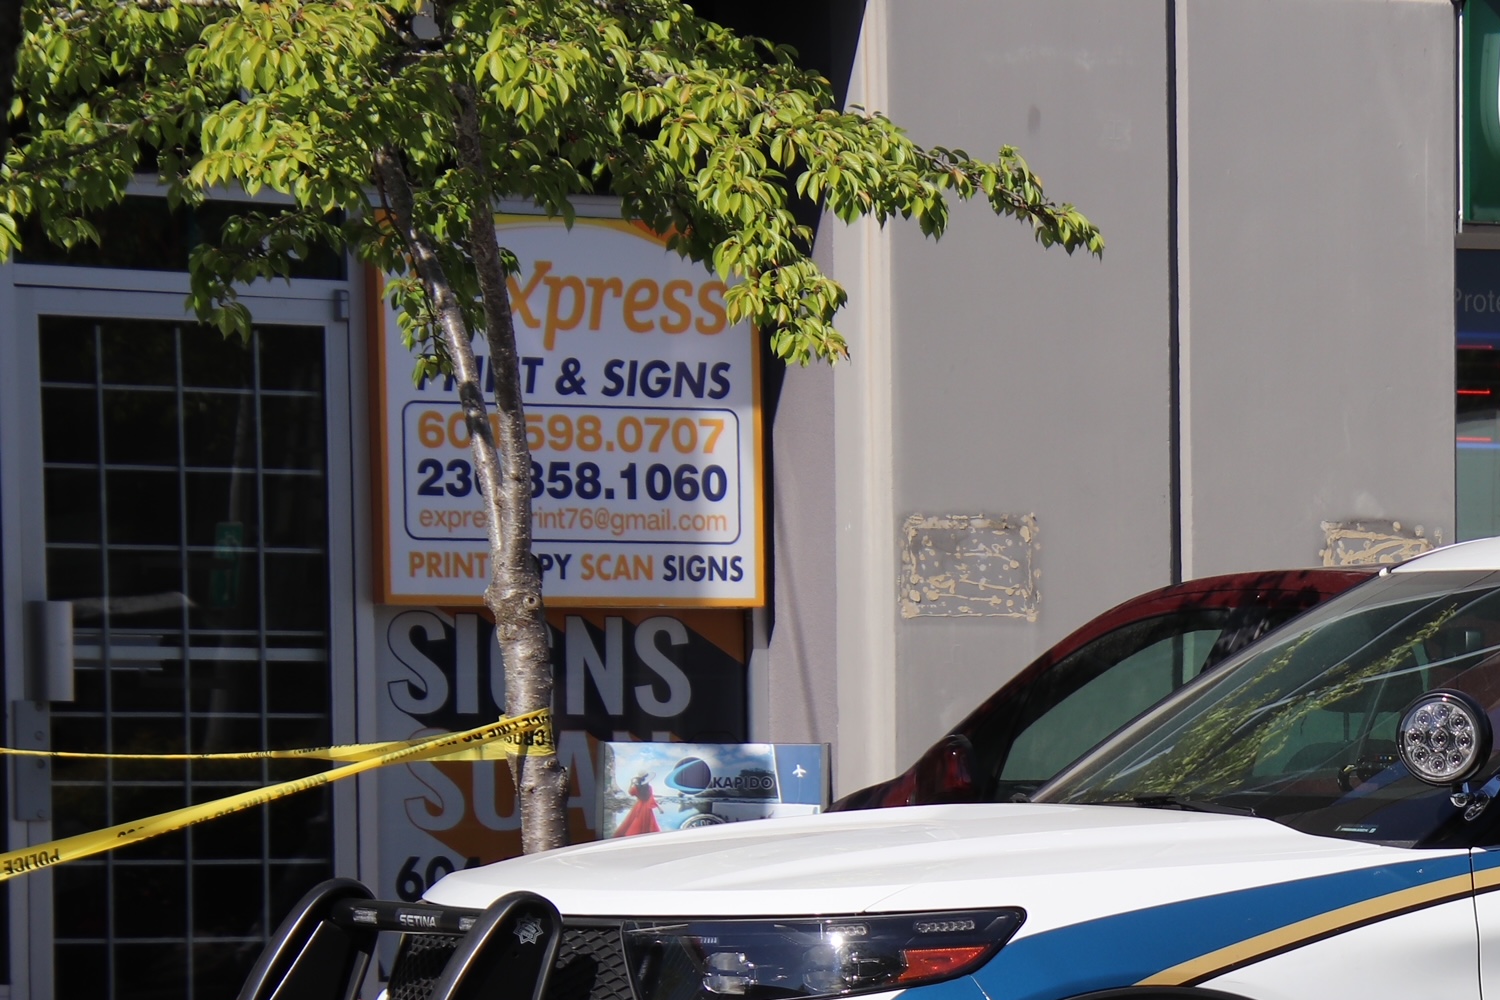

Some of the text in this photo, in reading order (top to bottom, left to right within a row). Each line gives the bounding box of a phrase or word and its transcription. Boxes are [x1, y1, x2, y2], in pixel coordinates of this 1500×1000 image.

[510, 260, 730, 351] xpress
[556, 357, 587, 396] &
[602, 360, 731, 399] SIGNS
[409, 551, 488, 578] PRINT
[580, 553, 654, 581] SCAN
[662, 554, 744, 582] SIGNS
[713, 776, 775, 791] KAPIDO
[399, 914, 437, 928] SETINA
